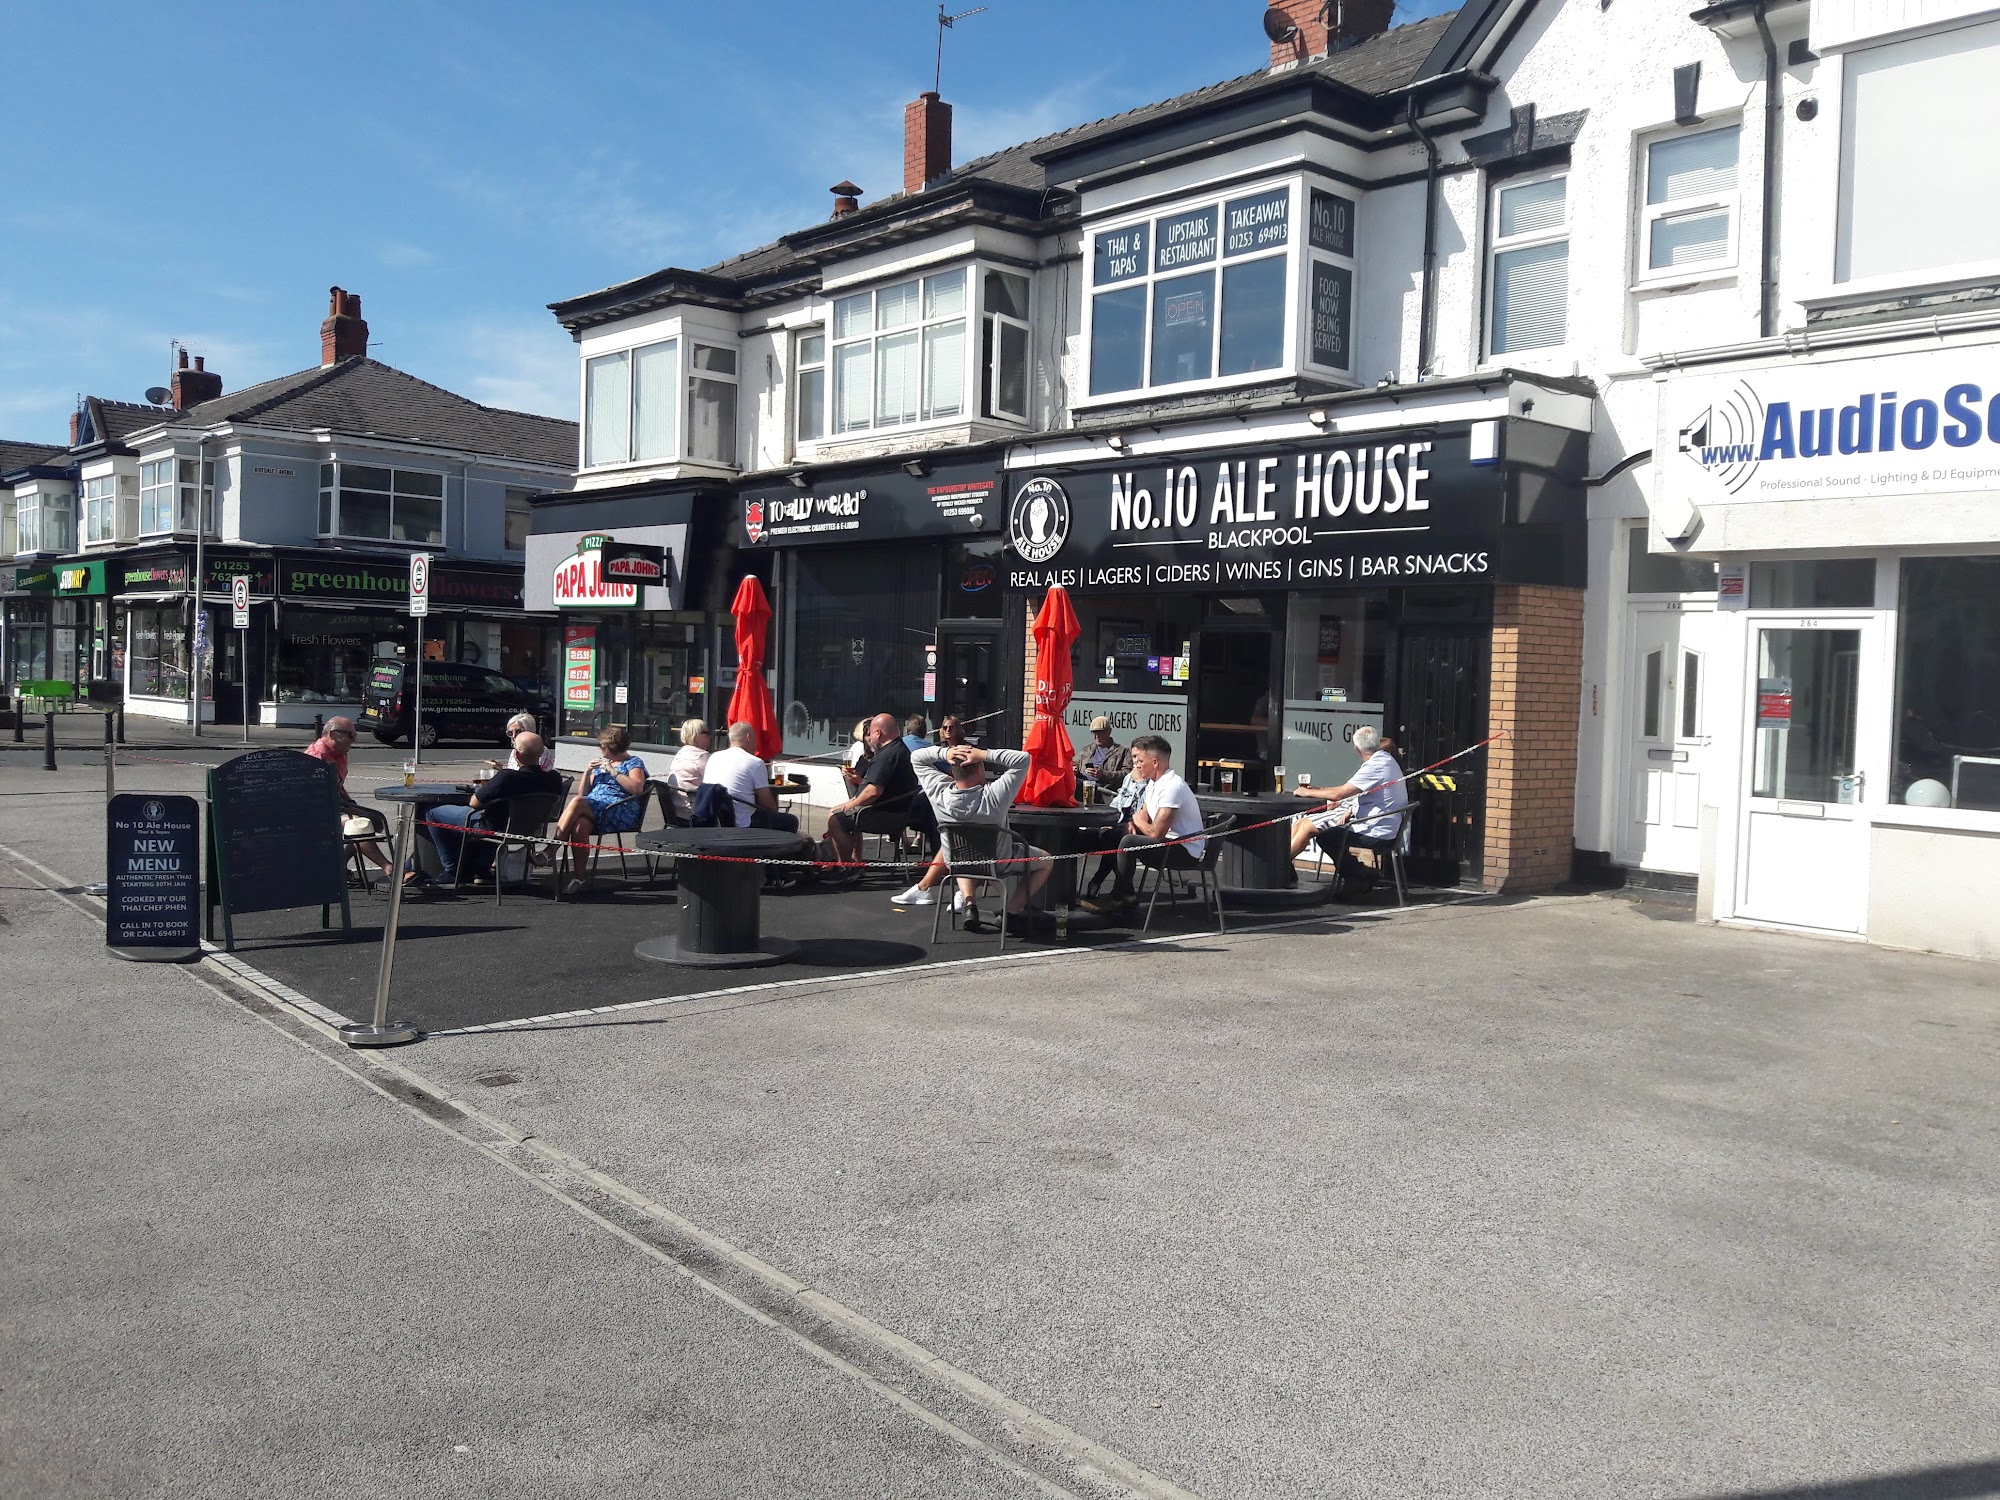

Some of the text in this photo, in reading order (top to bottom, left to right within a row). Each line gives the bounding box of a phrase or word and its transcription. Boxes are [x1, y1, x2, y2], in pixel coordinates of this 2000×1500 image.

[1231, 199, 1287, 229] TAKEAWAY
[1314, 199, 1345, 232] No.10
[1168, 217, 1208, 244] UPSTAIRS
[1229, 224, 1288, 250] 01253 694913
[1312, 228, 1344, 248] ALE HOUSE
[1107, 233, 1142, 257] THAI &
[1160, 237, 1216, 266] RESTAURANT
[1110, 255, 1137, 277] TAPAS
[1319, 277, 1340, 297] FOOD
[1167, 298, 1204, 318] OPEN
[1319, 296, 1339, 316] NOW
[1317, 314, 1340, 335] BEING
[1314, 332, 1341, 353] SERVED
[967, 481, 994, 490] WHITEGATE
[1028, 482, 1053, 495] No.10
[1110, 442, 1432, 530] No.10 ALE HOUSE
[1760, 477, 1823, 490] Professional
[1825, 475, 1860, 486] Sound
[1871, 471, 1918, 486] Lighting
[1921, 471, 1929, 480] &
[1933, 470, 1947, 480] DJ
[770, 527, 787, 535] PREMIER
[788, 525, 811, 533] ELECTRONIC
[812, 523, 835, 532] CIGARETTES
[1208, 526, 1313, 549] BLACKPOOL
[1015, 533, 1061, 558] ALE HOUSE
[214, 561, 250, 571] 01253
[610, 560, 659, 575] PAPA JOHN'S
[1010, 552, 1489, 588] REAL ALES LAGERS CIDERS WINES GINS BAR SNACKS
[18, 572, 49, 587] SUBWAY
[60, 568, 86, 590] SUBWAY
[211, 572, 253, 583] 7622
[556, 562, 587, 598] PAPA
[292, 634, 361, 646] Fresh Flowers
[1117, 638, 1151, 651] OPEN
[1072, 710, 1093, 727] ALES
[1103, 711, 1138, 729] AGERS
[1148, 713, 1182, 732] CIDERS
[1294, 721, 1372, 743] WINES GI
[115, 821, 192, 829] No 10 Ale House
[134, 839, 175, 852] NEW
[128, 858, 180, 871] MENU
